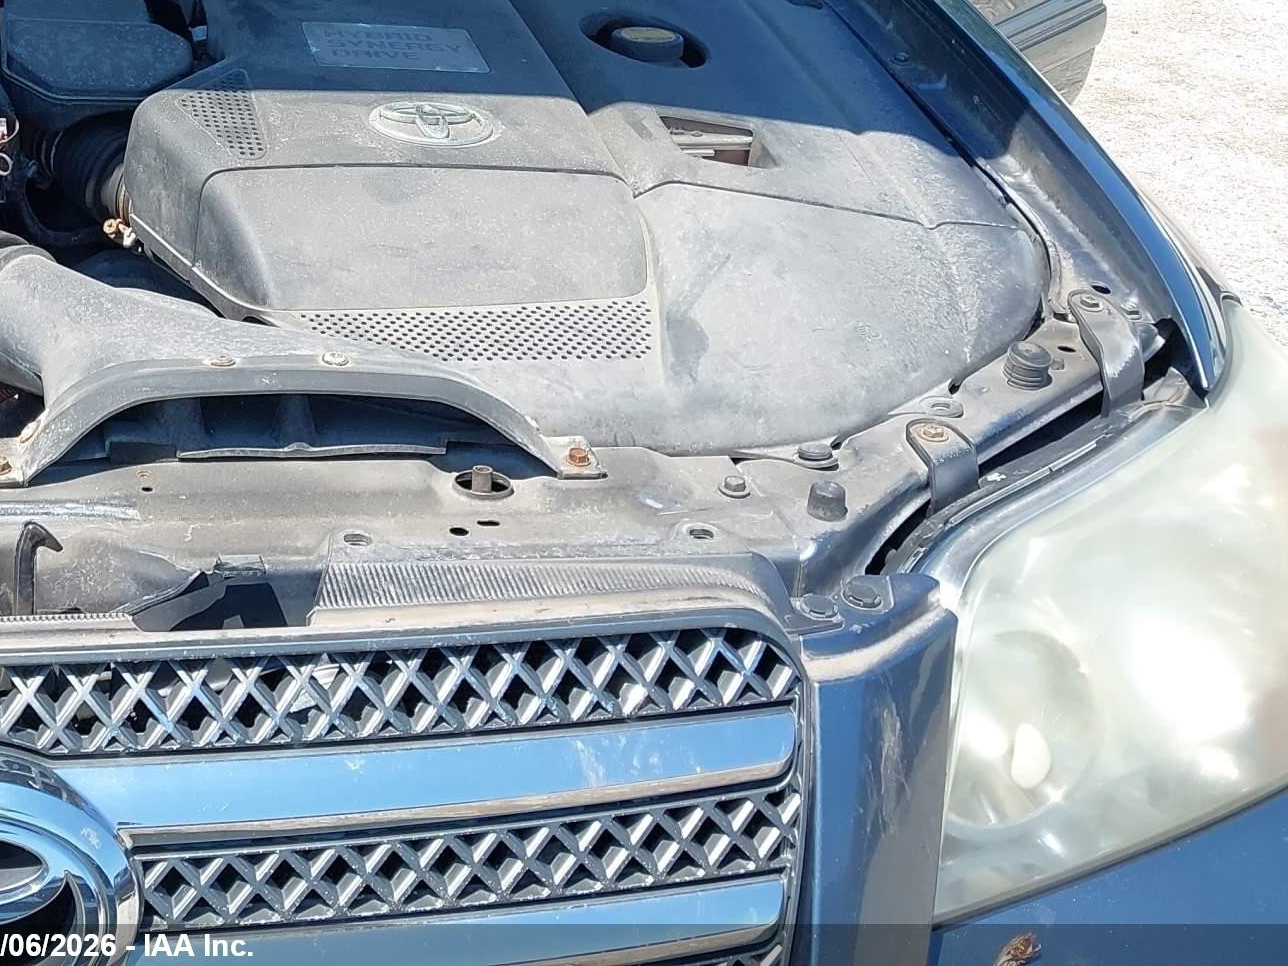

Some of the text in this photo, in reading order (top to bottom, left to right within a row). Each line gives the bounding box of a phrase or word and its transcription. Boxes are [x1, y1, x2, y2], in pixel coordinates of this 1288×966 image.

[324, 29, 432, 42] HYBRID
[327, 39, 460, 52] SYNERGY
[332, 49, 420, 60] DRIVE
